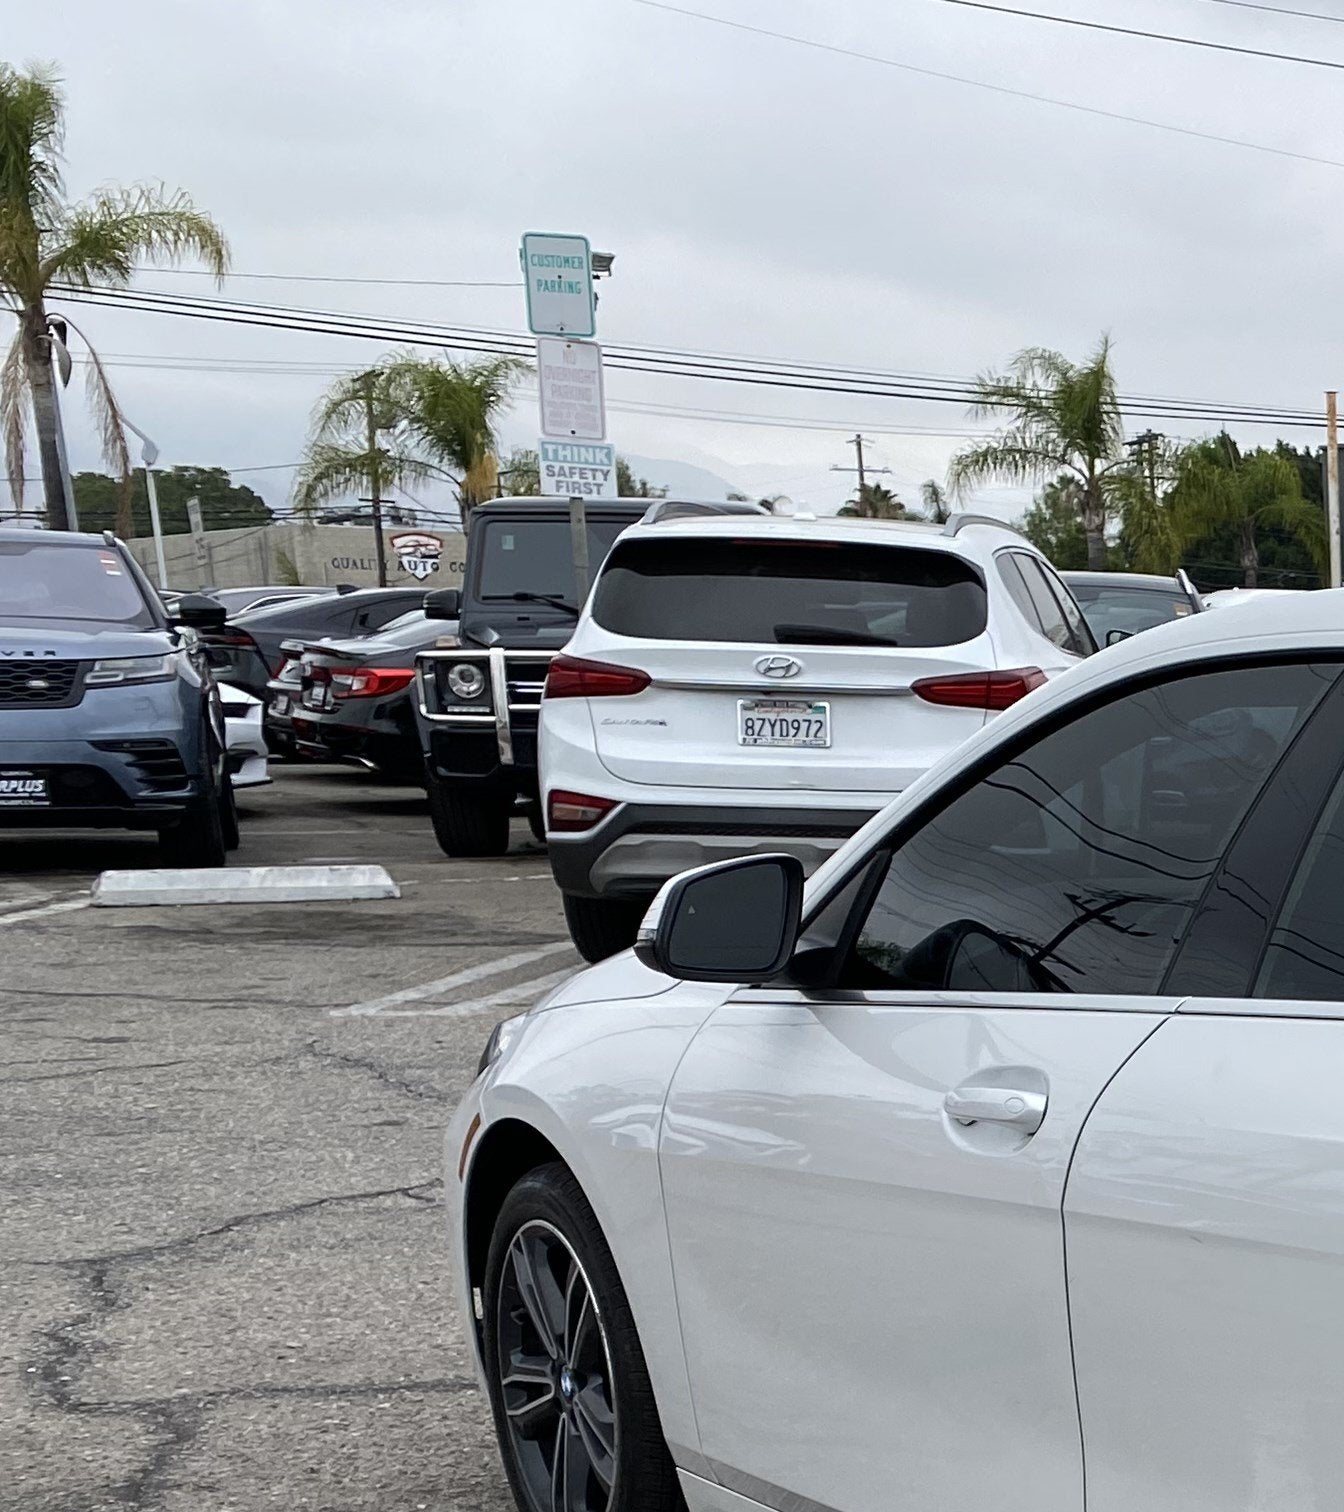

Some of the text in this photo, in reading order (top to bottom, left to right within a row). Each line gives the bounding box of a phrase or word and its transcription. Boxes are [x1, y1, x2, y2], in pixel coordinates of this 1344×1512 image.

[530, 253, 584, 270] CUSTOMER
[536, 279, 582, 295] PARKING
[543, 444, 612, 464] THINK
[545, 464, 611, 482] SAFETY
[555, 480, 603, 496] FIRST
[397, 560, 440, 572] AUTO
[745, 717, 823, 739] 8ZYD972
[0, 780, 45, 793] RPLUS
